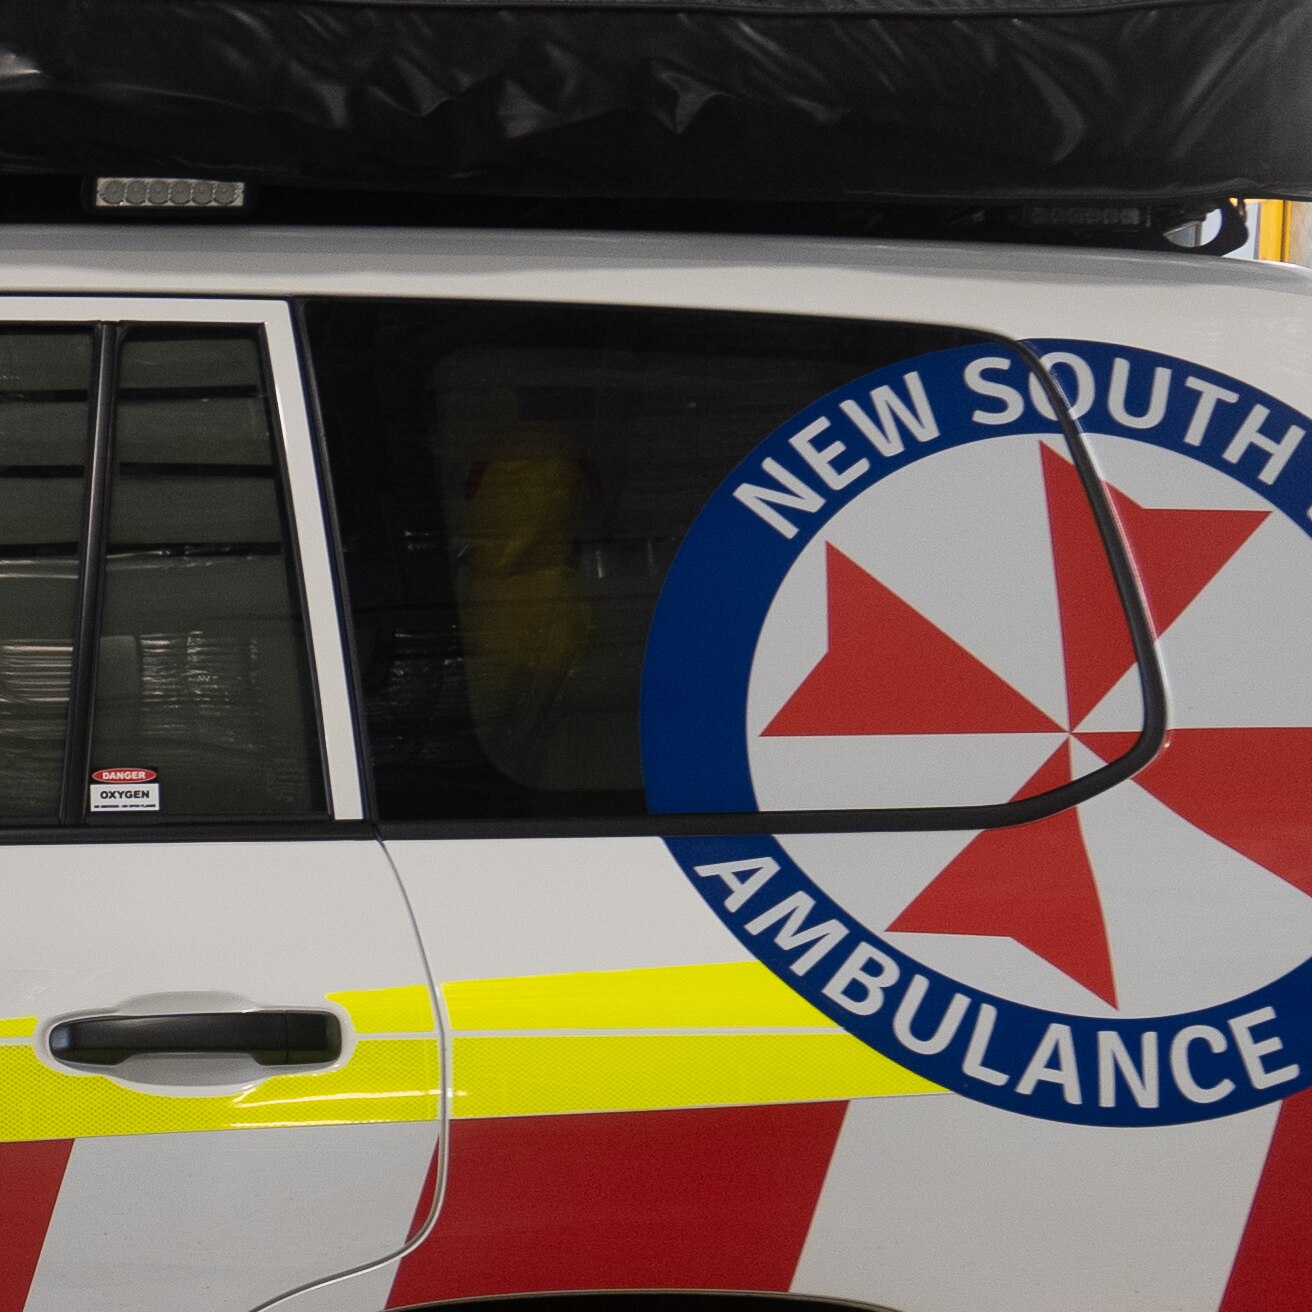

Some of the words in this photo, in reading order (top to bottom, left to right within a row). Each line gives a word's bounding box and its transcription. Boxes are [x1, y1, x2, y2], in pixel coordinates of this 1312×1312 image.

[733, 371, 940, 540] NEW
[962, 350, 1307, 486] SOUTH
[99, 790, 151, 800] OXYGEN
[102, 771, 147, 780] DANGER
[694, 854, 1301, 1110] AMBULANCE
